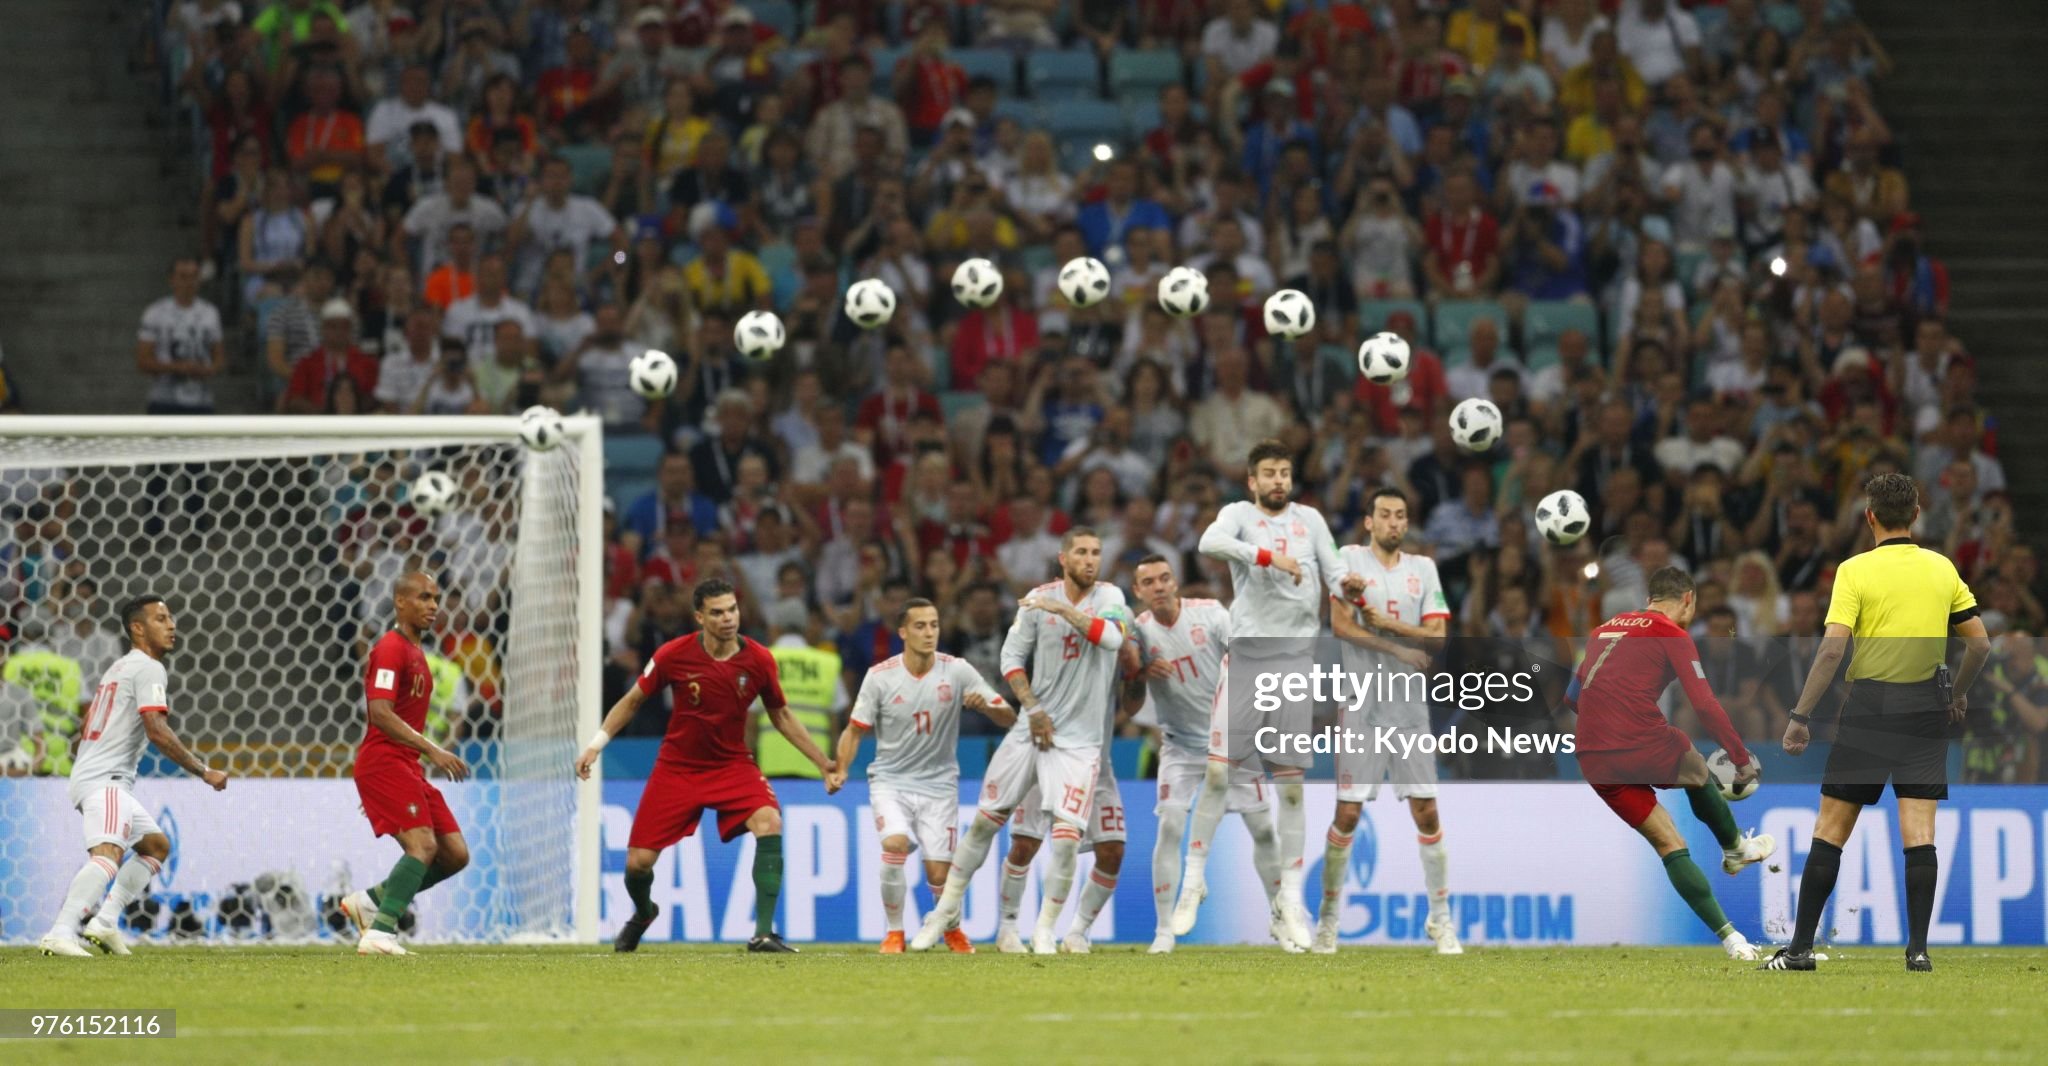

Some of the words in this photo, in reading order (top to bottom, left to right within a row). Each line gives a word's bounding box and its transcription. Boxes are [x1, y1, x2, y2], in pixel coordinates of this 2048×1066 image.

[1062, 633, 1081, 660] 15
[1171, 655, 1199, 683] 17
[1582, 632, 1629, 690] 7
[410, 673, 425, 698] 10
[688, 682, 701, 706] 3
[1063, 784, 1085, 815] 15
[1101, 806, 1125, 833] 22
[1760, 807, 2048, 944] GAZP
[1387, 893, 1574, 941] GAPROM
